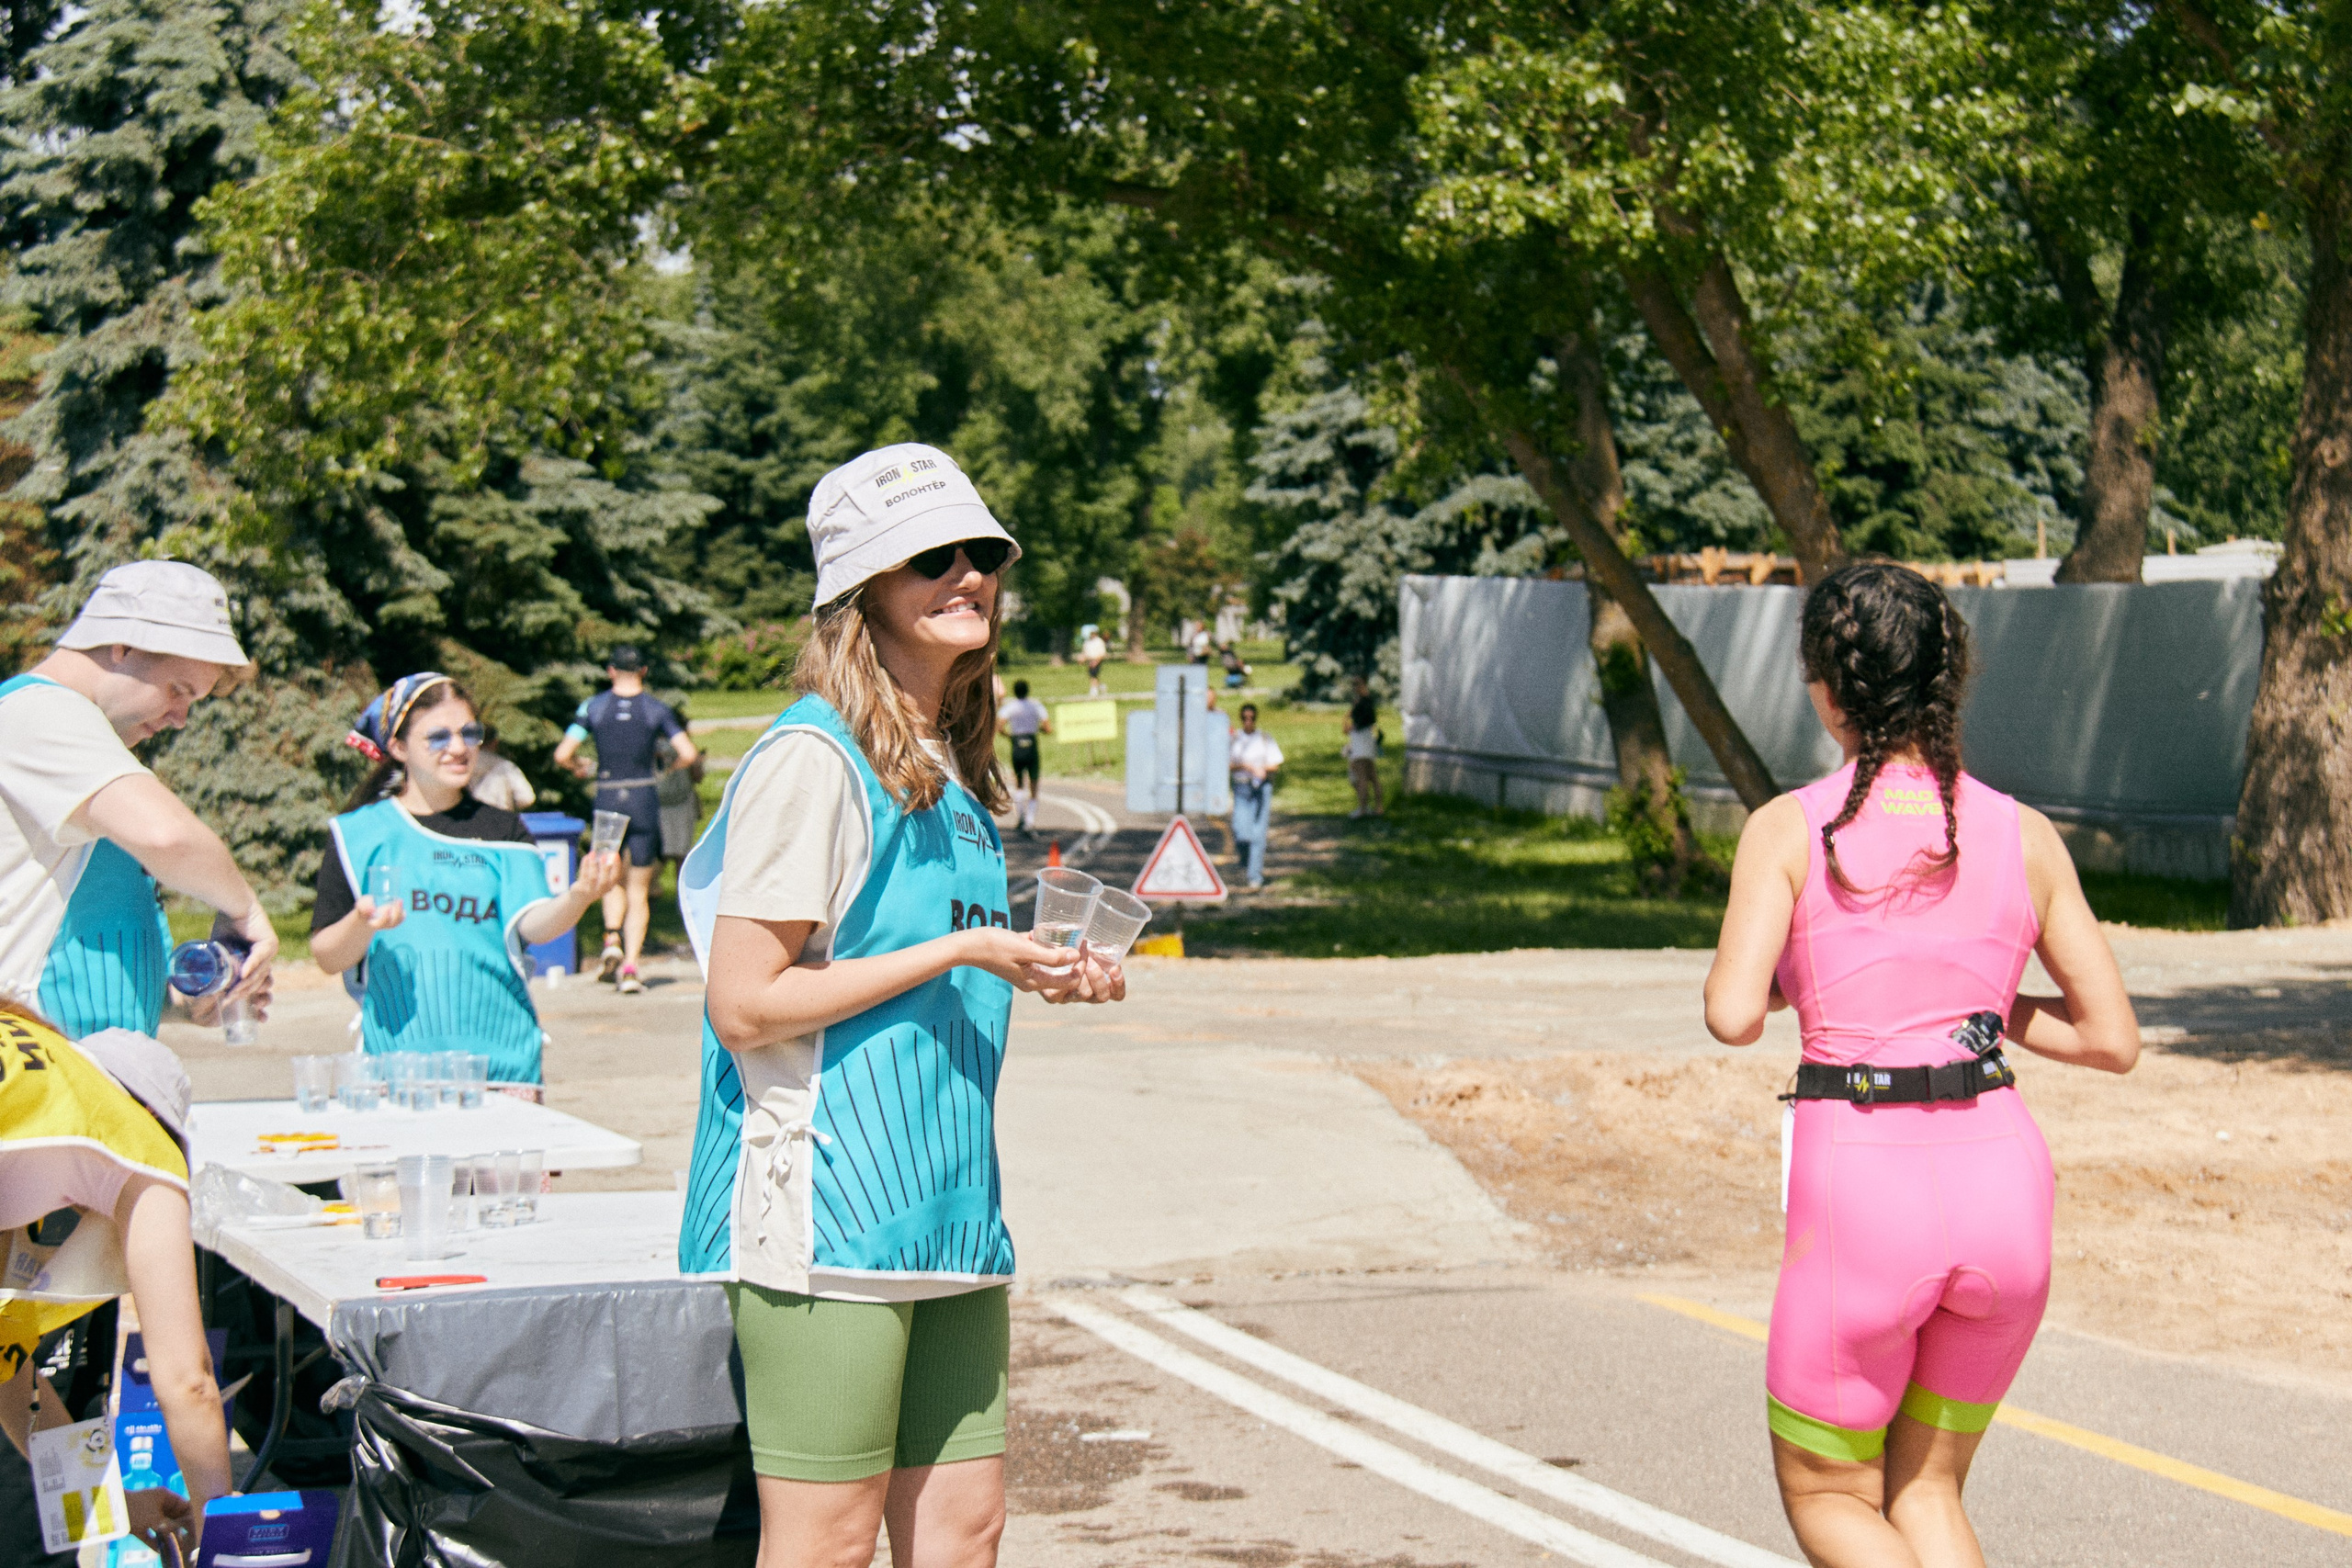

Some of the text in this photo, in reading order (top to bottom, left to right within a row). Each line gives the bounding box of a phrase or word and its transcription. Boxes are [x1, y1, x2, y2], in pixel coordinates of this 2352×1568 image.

[875, 459, 937, 488] IRON STAR
[885, 480, 946, 507] ВОЛОНТЁР
[1883, 788, 1934, 801] MAD
[1880, 801, 1942, 816] WAVE
[952, 809, 977, 835] IRON
[412, 889, 500, 924] ВОДА
